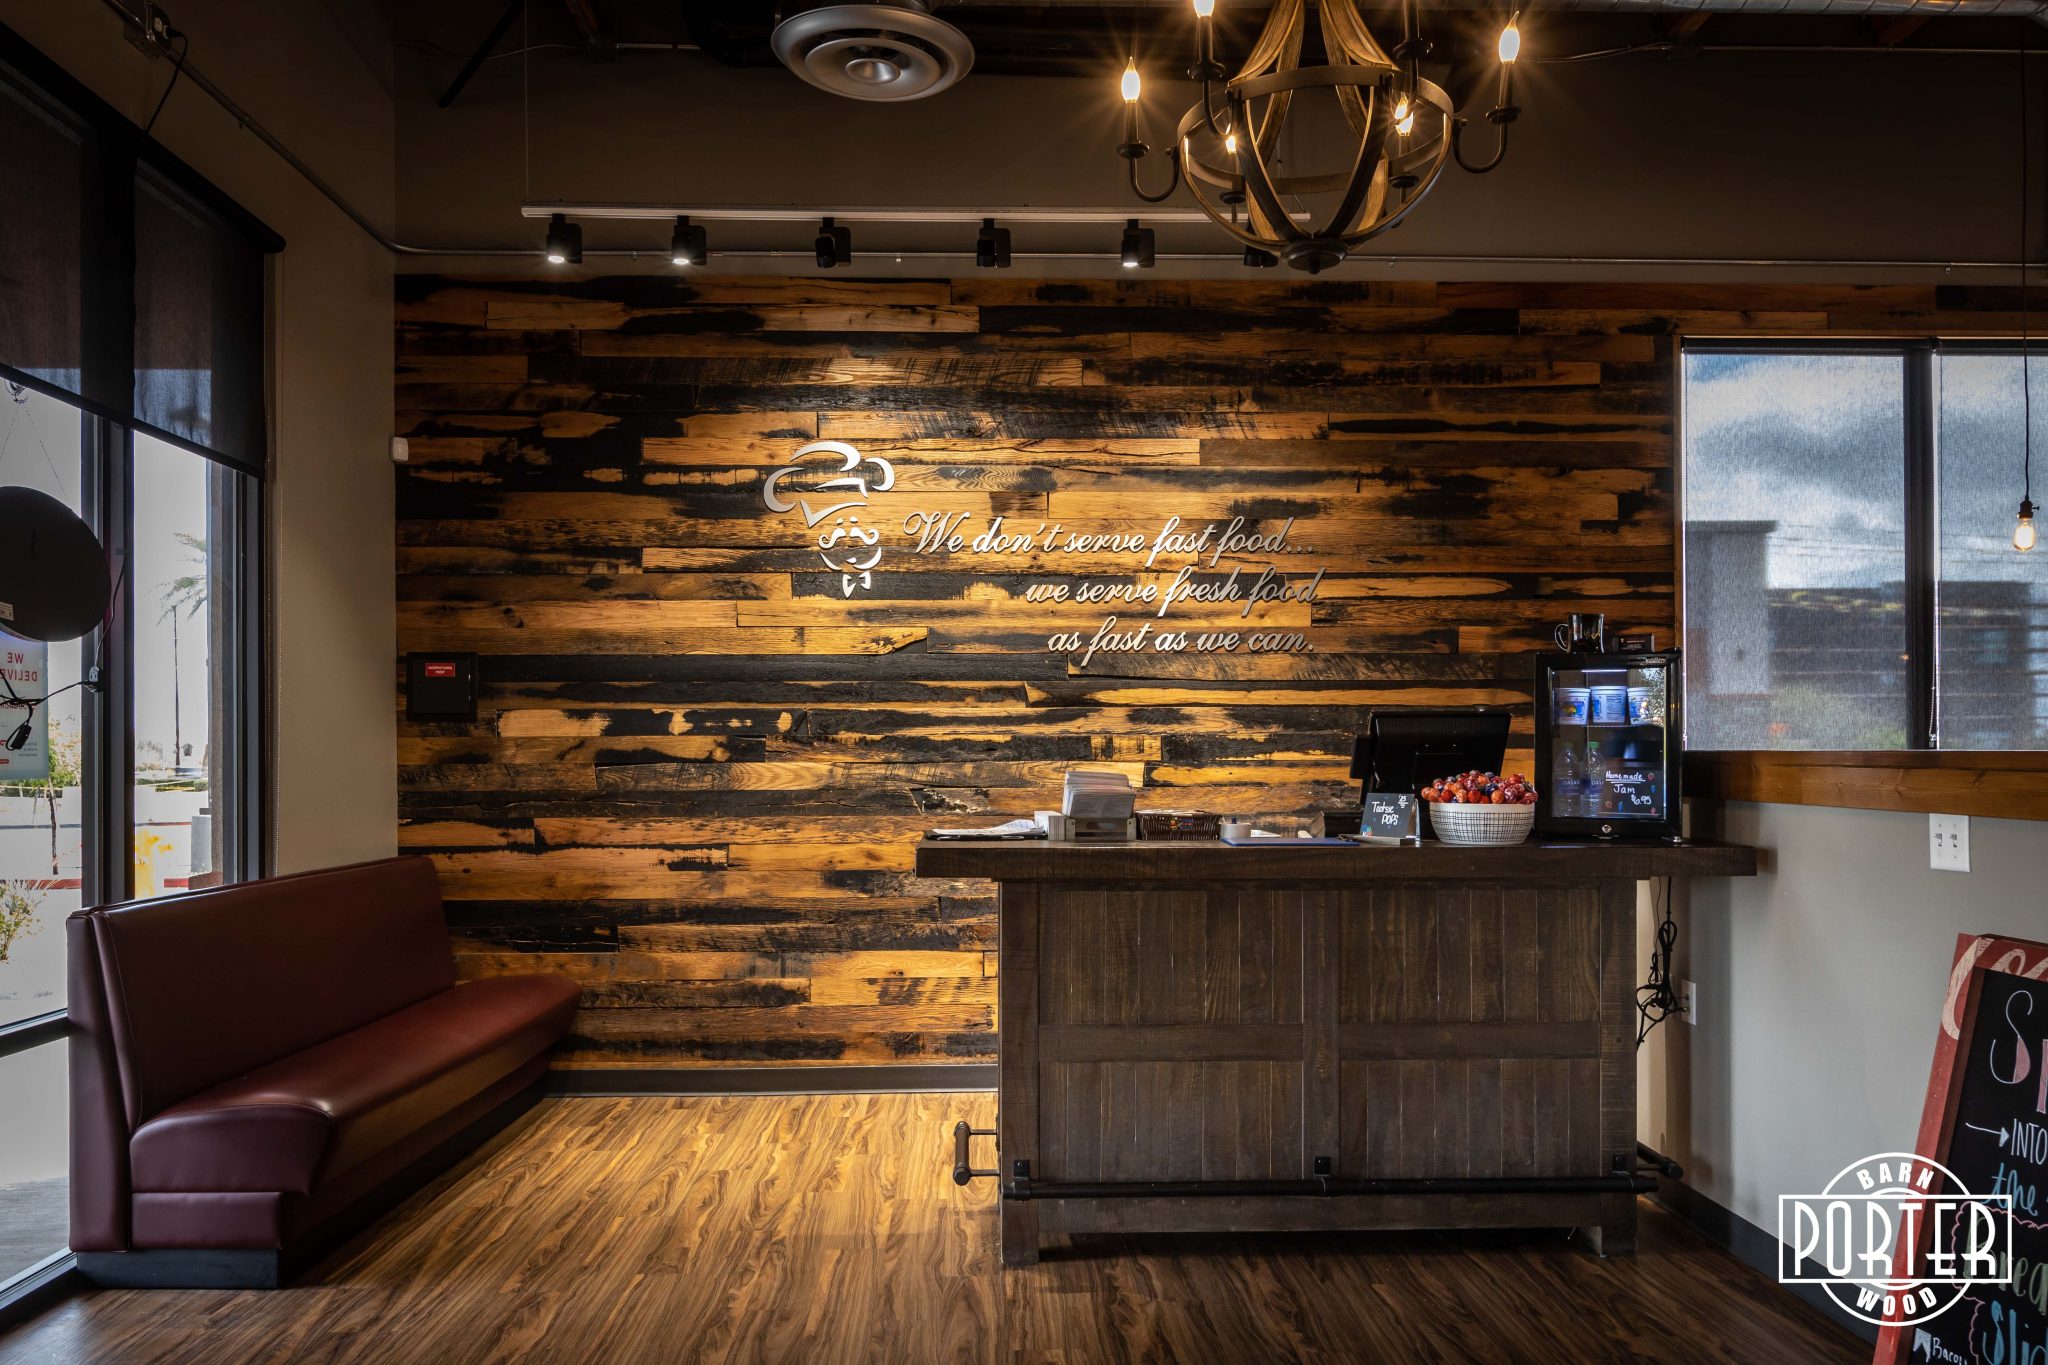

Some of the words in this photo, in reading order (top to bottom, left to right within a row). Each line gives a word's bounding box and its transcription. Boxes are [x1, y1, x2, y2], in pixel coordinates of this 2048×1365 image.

[903, 511, 970, 554] We
[972, 516, 1063, 553] don't
[1063, 532, 1145, 553] serve
[1145, 516, 1217, 567] fast
[1209, 516, 1313, 568] food...
[1026, 584, 1069, 602] we
[1076, 582, 1158, 602] serve
[1157, 566, 1241, 617] fresh
[1241, 566, 1326, 618] food
[1047, 631, 1082, 651] as
[1080, 615, 1153, 667] fast
[1154, 631, 1188, 651] as
[1196, 631, 1240, 651] we
[1247, 631, 1314, 651] can.
[1613, 783, 1636, 794] Jam
[2010, 1117, 2048, 1165] INTO
[1980, 1162, 2038, 1217] the
